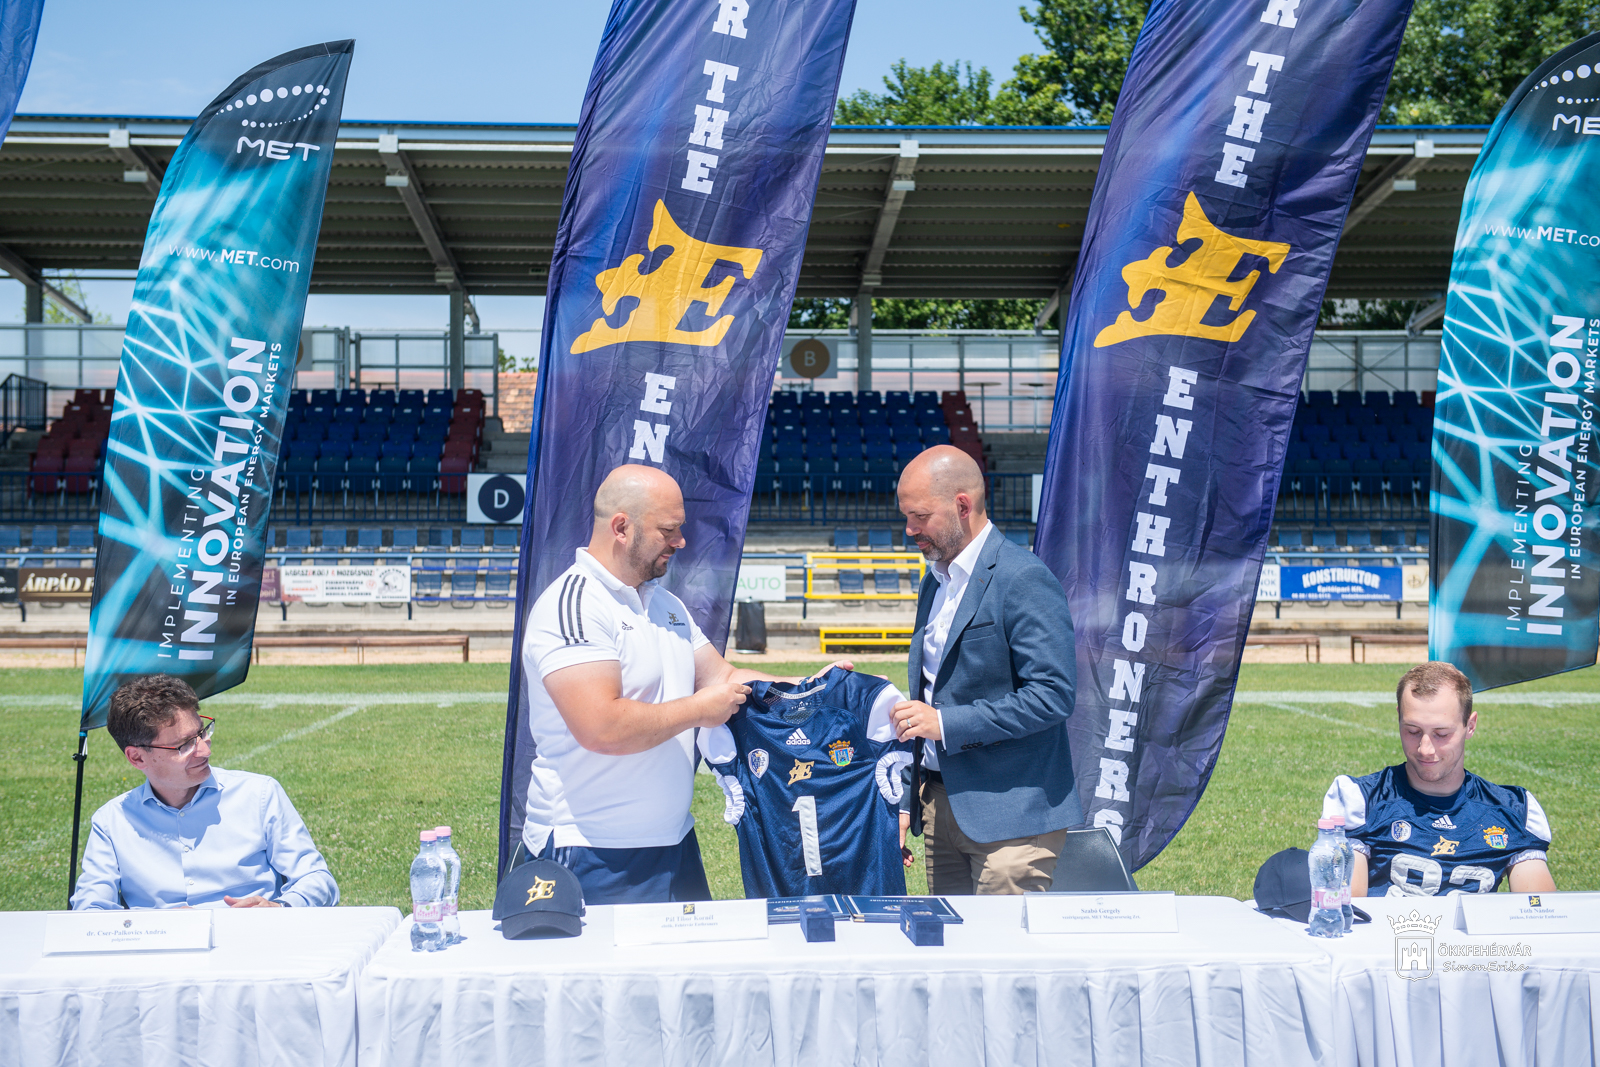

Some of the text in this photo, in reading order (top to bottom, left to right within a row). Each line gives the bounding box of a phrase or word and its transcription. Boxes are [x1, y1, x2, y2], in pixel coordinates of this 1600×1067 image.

[236, 136, 320, 161] MET
[680, 59, 739, 195] THE
[1214, 50, 1285, 188] THE
[168, 243, 300, 273] www.MET.com
[803, 351, 816, 367] B
[178, 337, 267, 661] INNOVATION
[226, 342, 282, 605] IN EUROPEAN ENERGY MARKETS
[493, 488, 510, 509] D
[1526, 314, 1586, 636] INNOVATION
[1570, 318, 1600, 579] IN EUROPEAN ENERGY MARKETS
[21, 572, 82, 593] ÁRPÁD
[157, 467, 205, 658] IMPLEMENTING
[1301, 567, 1381, 590] KONSTRUKTOR
[1506, 444, 1533, 631] IMPLEMENTING
[791, 795, 823, 876] 1
[1431, 822, 1457, 830] adidas
